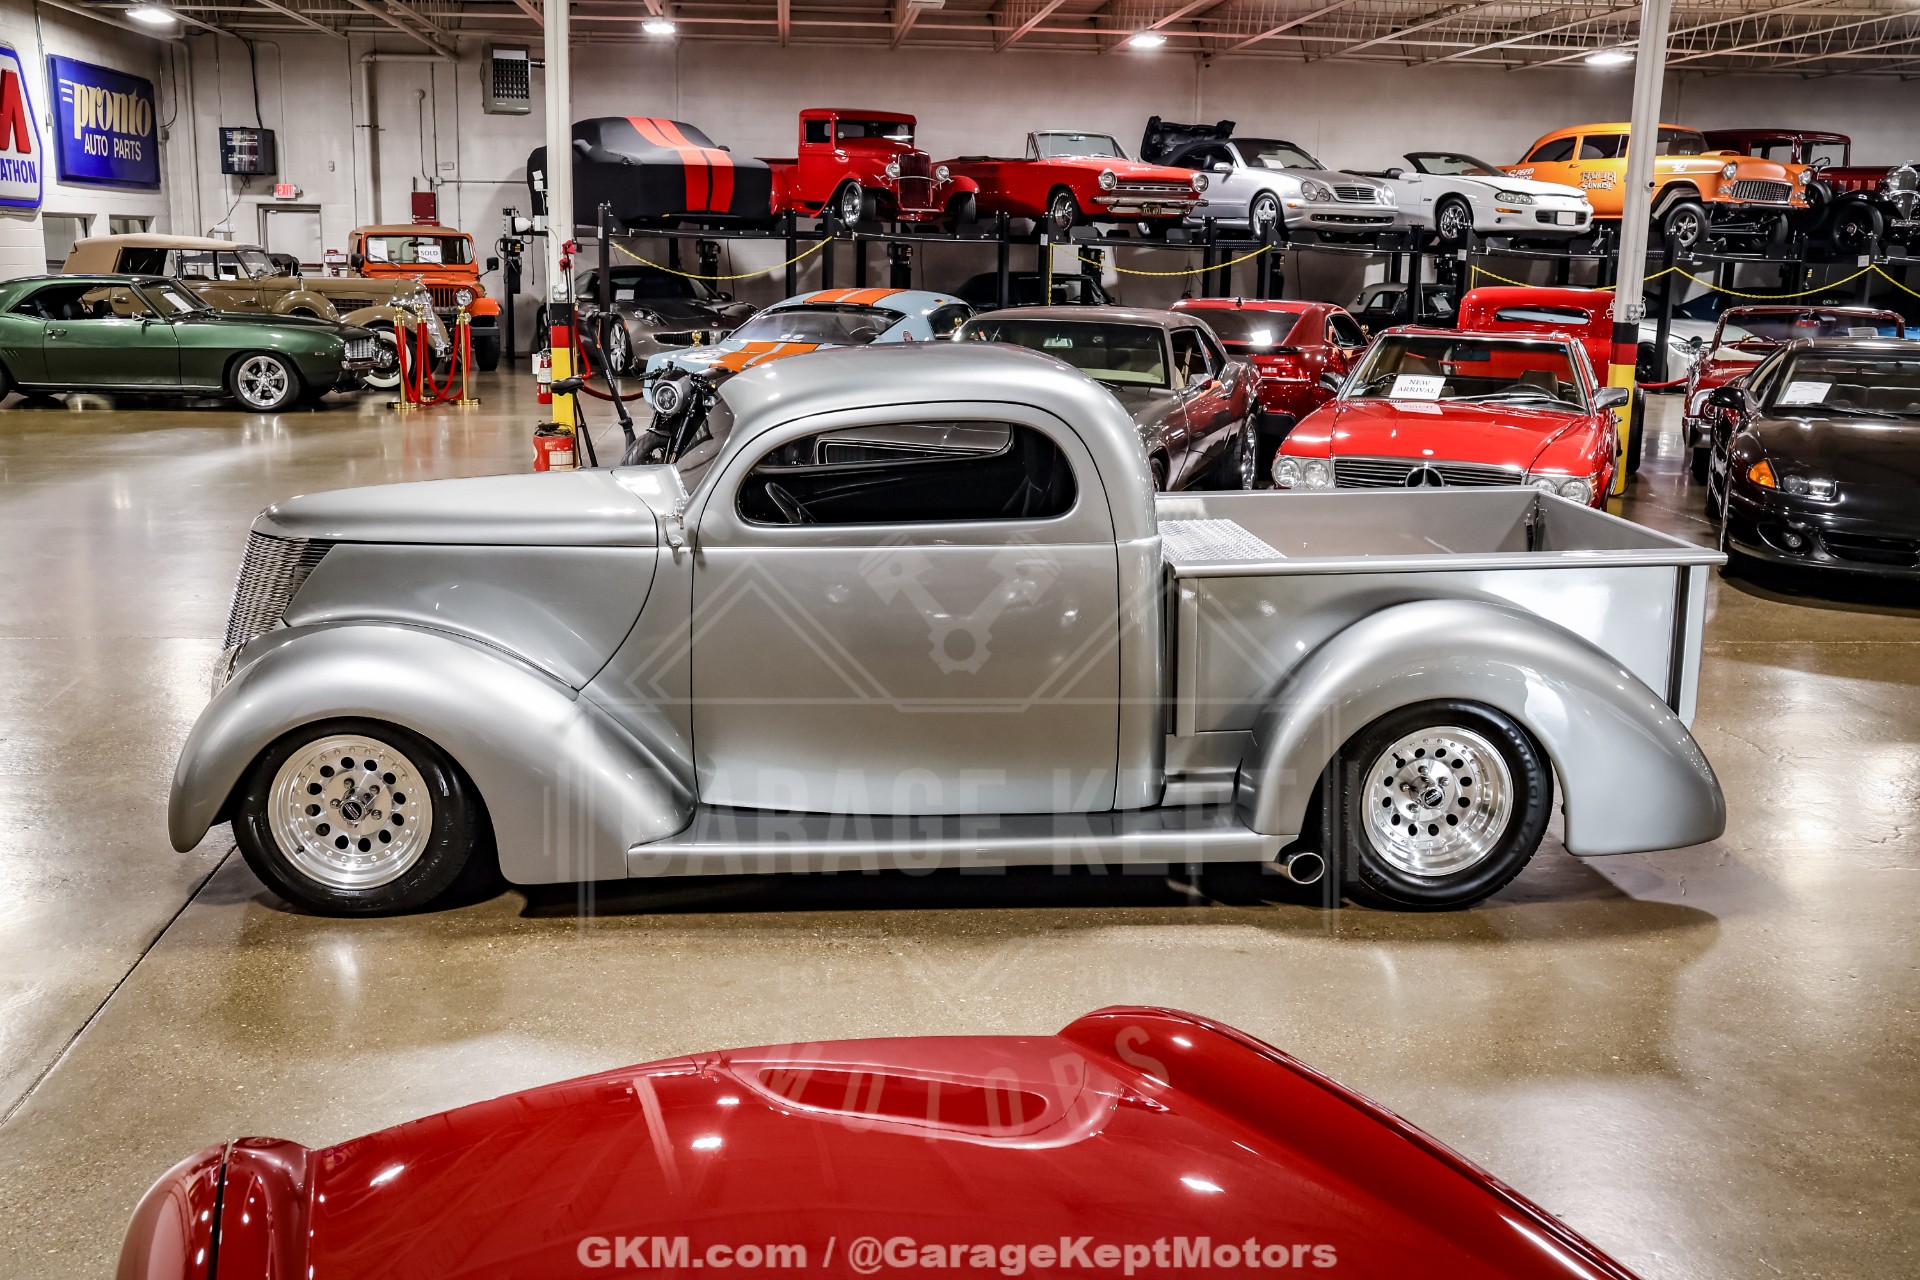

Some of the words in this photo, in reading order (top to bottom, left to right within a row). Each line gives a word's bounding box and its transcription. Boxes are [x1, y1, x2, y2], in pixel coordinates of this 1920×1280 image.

[72, 82, 152, 139] pronto
[84, 133, 109, 157] AUTO
[113, 137, 142, 161] PARTS
[276, 183, 293, 196] EXIT
[1396, 386, 1436, 394] ARRIVAL
